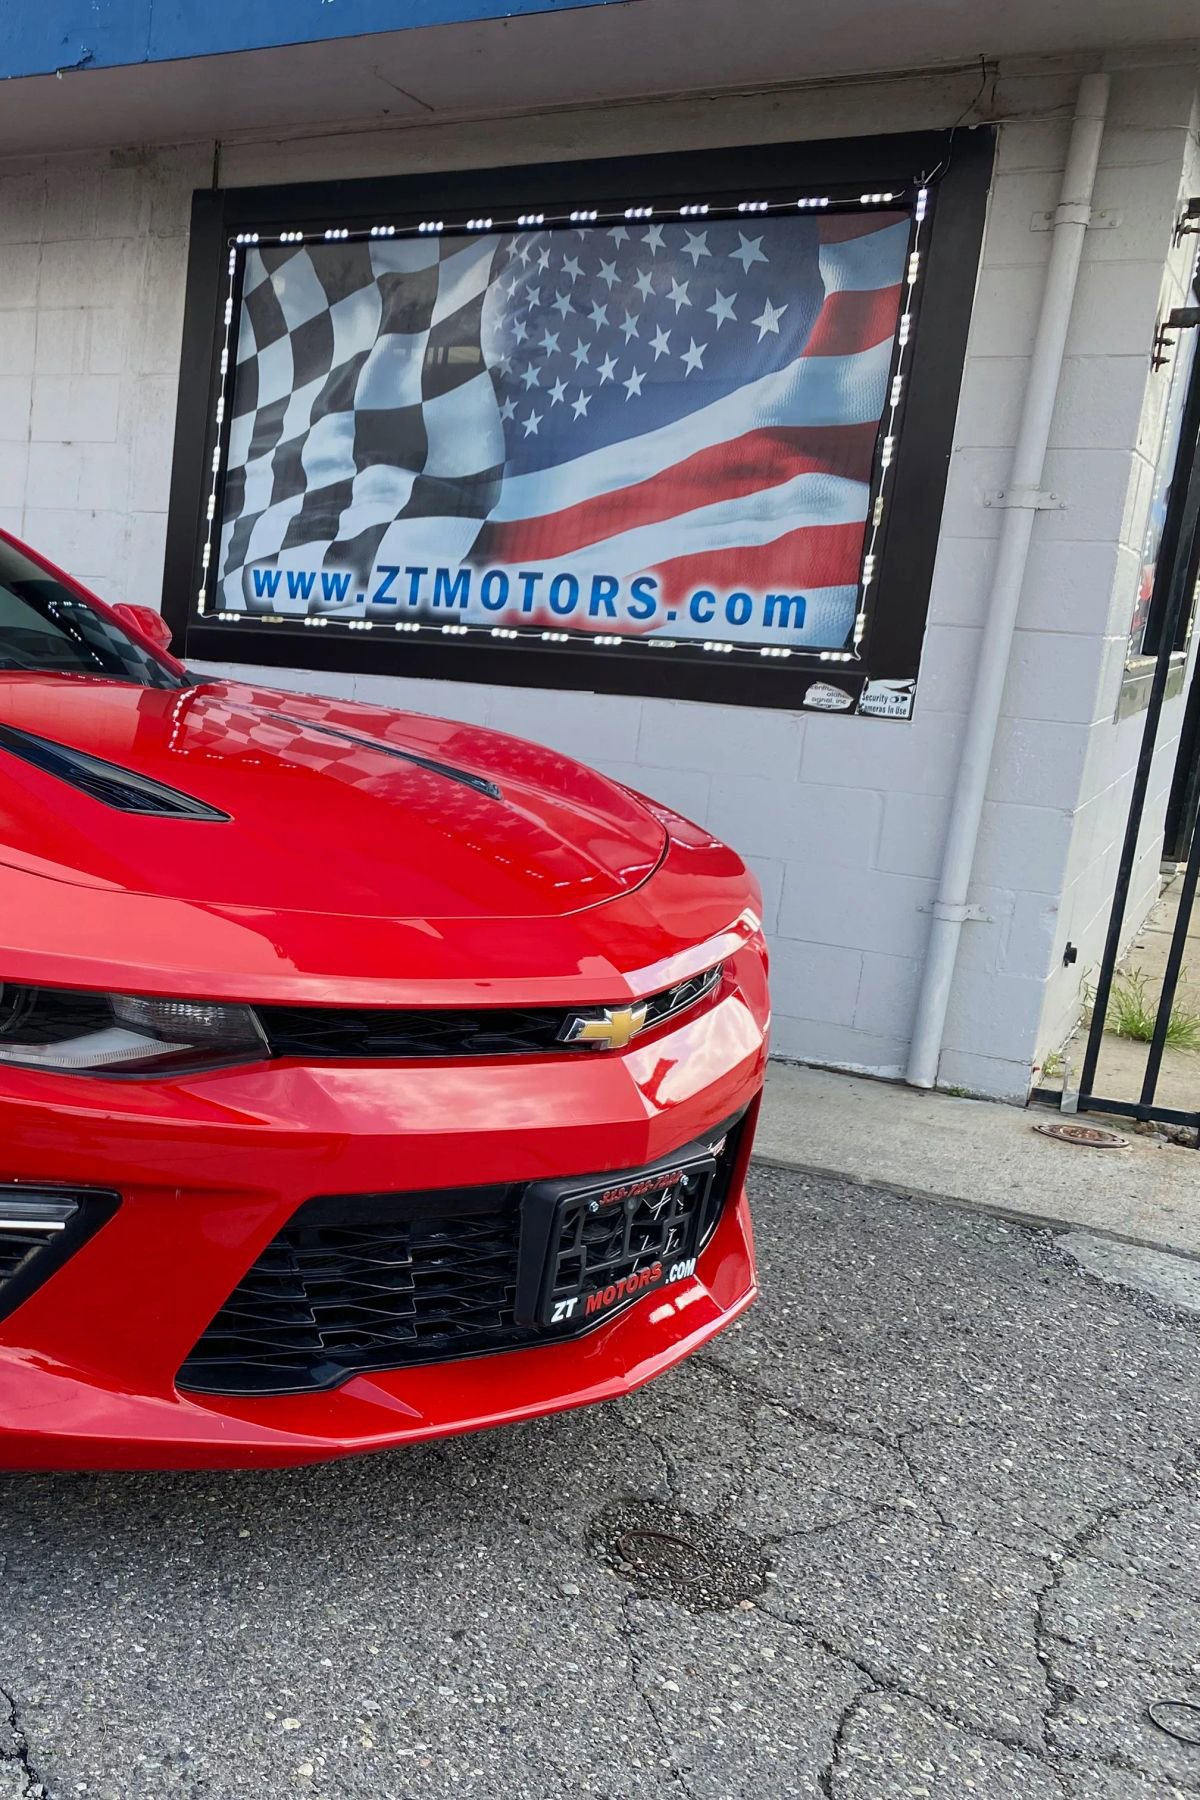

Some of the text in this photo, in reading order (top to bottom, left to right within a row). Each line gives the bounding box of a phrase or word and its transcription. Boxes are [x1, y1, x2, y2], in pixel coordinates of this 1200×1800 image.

[253, 565, 806, 629] www.ZTMOTORS.com
[862, 692, 889, 705] Security
[896, 706, 907, 716] Use
[551, 1297, 578, 1322] ZT
[585, 1261, 663, 1317] MOTORS
